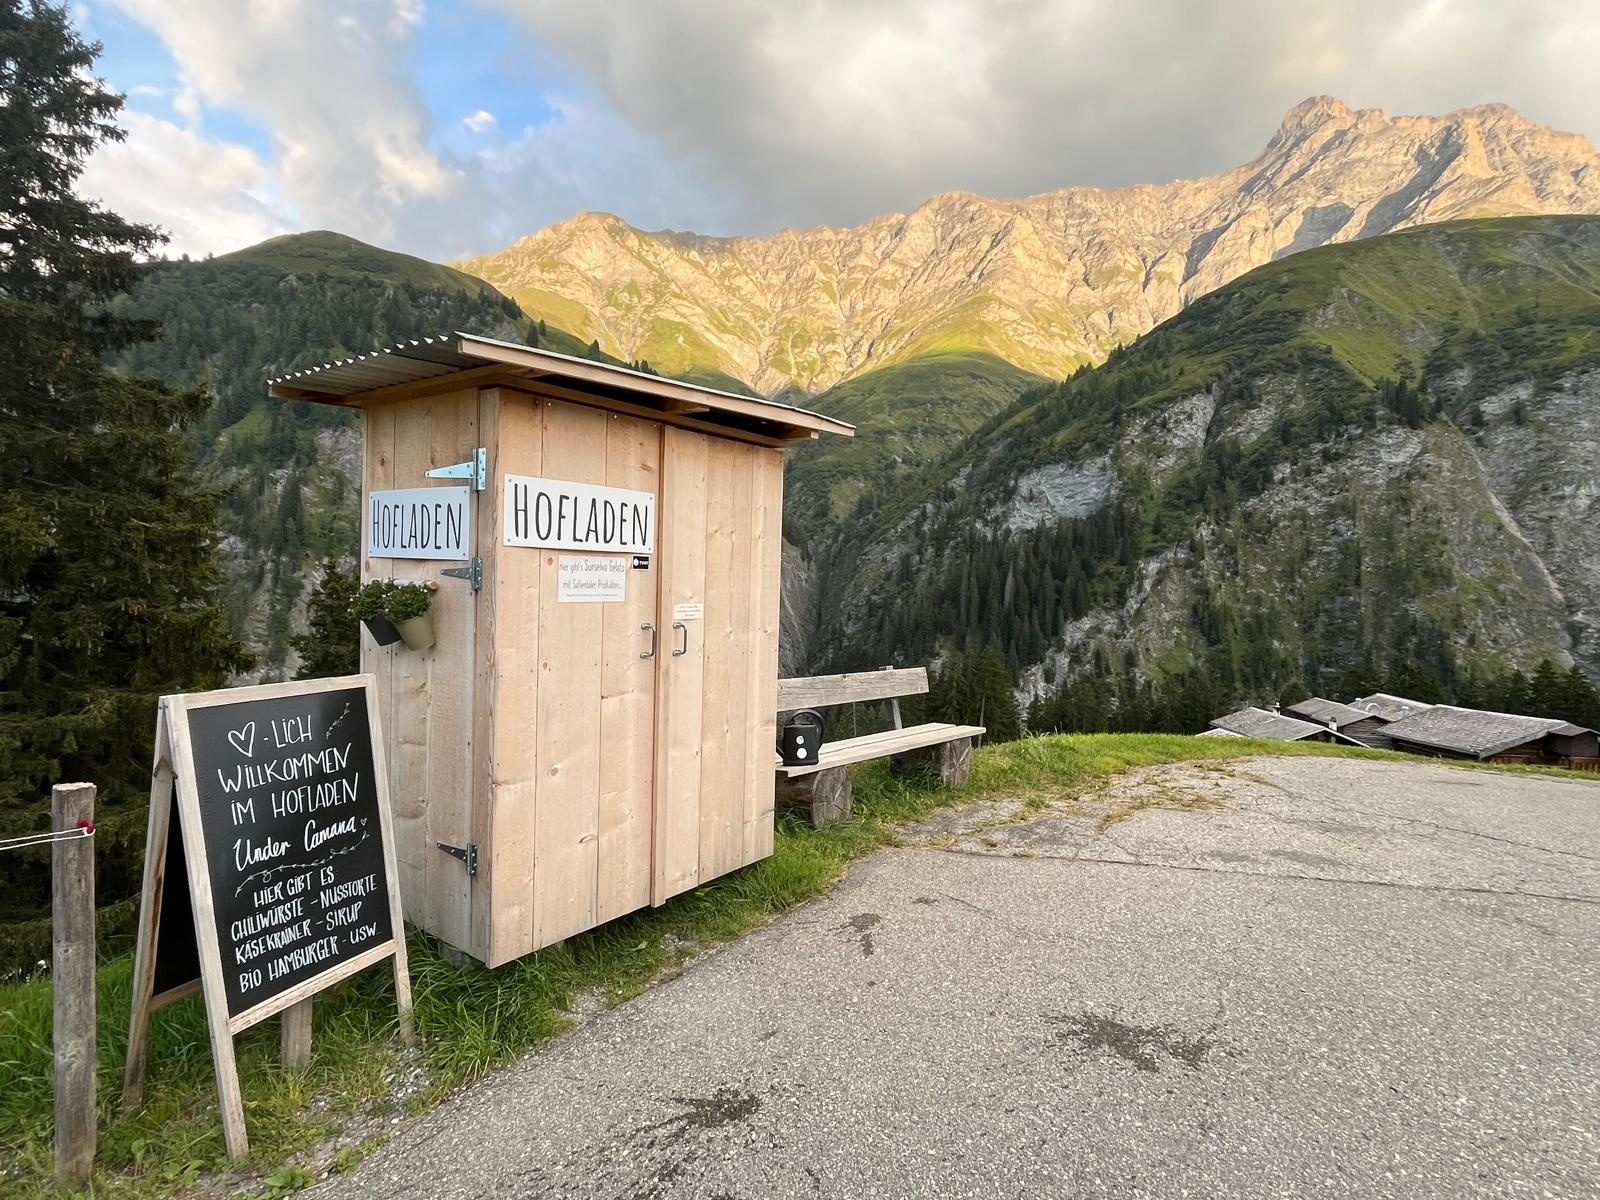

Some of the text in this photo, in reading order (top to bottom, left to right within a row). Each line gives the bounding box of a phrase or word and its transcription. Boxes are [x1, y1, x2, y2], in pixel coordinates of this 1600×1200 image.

[372, 499, 462, 550] HOFLADEN
[514, 482, 649, 546] HOFLADEN
[217, 742, 351, 793] WILLKOMMEN
[231, 772, 358, 826] IM HOFLADEN
[232, 815, 357, 872] Under Camana
[231, 897, 305, 941] CHILIWÜRSTE
[319, 873, 377, 909] NUSSTORTE
[253, 865, 335, 908] HIER GIBT ES
[326, 901, 362, 931] SIRUP
[239, 968, 262, 993] BIO
[267, 935, 339, 981] HAMBURGER
